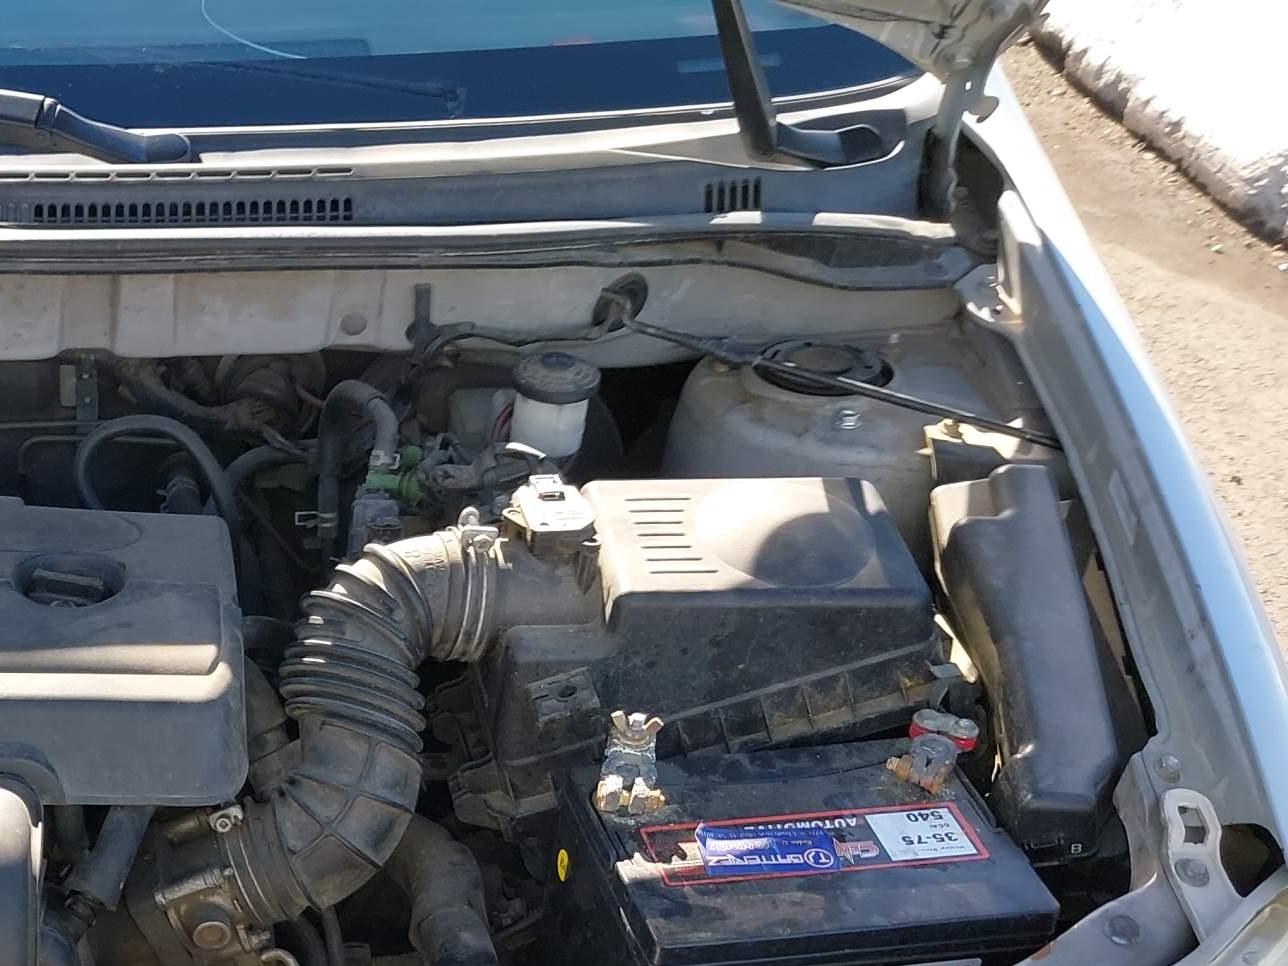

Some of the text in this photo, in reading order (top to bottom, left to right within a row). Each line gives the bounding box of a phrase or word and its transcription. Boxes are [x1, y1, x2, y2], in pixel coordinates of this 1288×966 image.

[744, 816, 858, 832] AUTOMO
[905, 810, 944, 823] 540
[901, 831, 959, 847] 35-75
